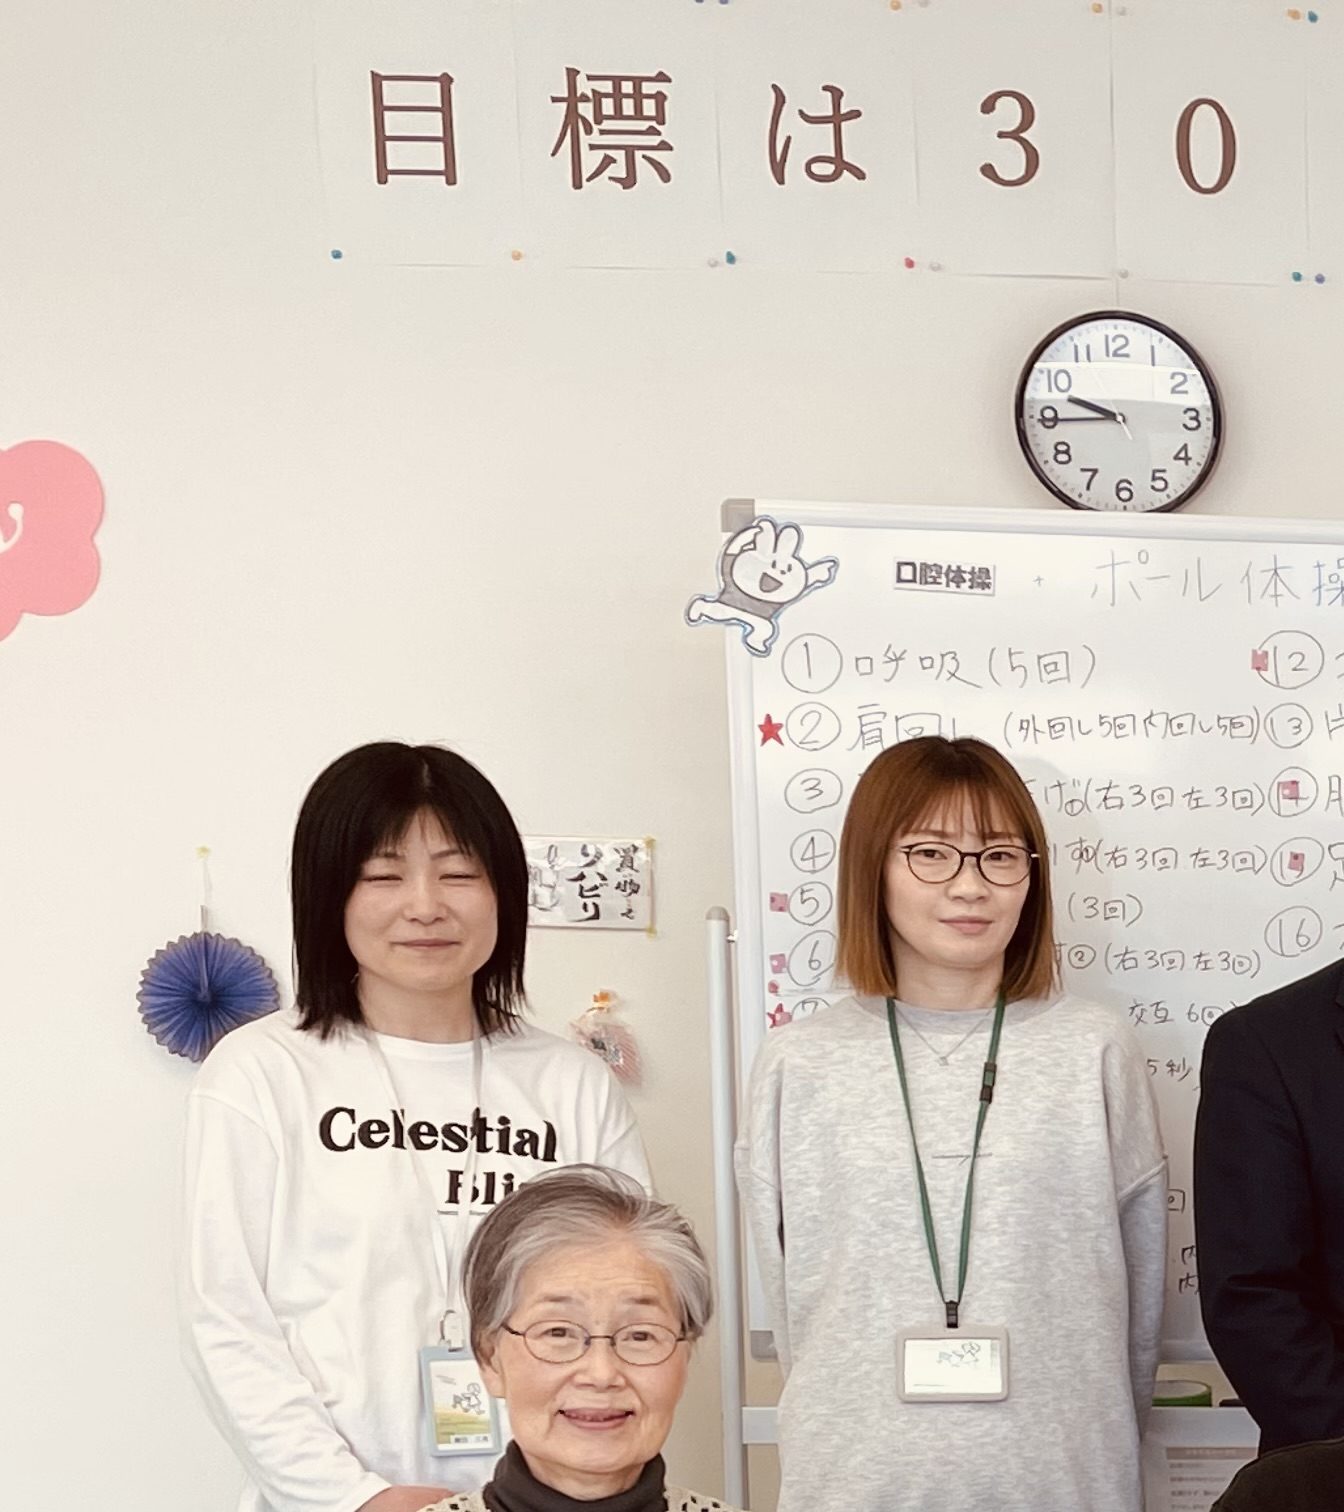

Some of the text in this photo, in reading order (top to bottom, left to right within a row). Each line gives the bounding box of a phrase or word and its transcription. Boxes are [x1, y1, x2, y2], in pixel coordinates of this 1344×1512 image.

[1073, 343, 1091, 363] 11
[1104, 334, 1131, 358] 12
[1150, 344, 1156, 367] 1
[1046, 369, 1072, 393] 10
[1170, 371, 1189, 394] 2
[1038, 406, 1059, 429] 9
[1182, 407, 1201, 431] 3
[1053, 441, 1072, 464] 8
[1173, 443, 1192, 466] 4
[1080, 468, 1099, 491] 7
[1115, 478, 1134, 502] 6
[1150, 469, 1168, 492] 5
[896, 561, 991, 590] 口腔体操
[319, 1106, 557, 1162] Celestial
[445, 1169, 515, 1205] Bli
